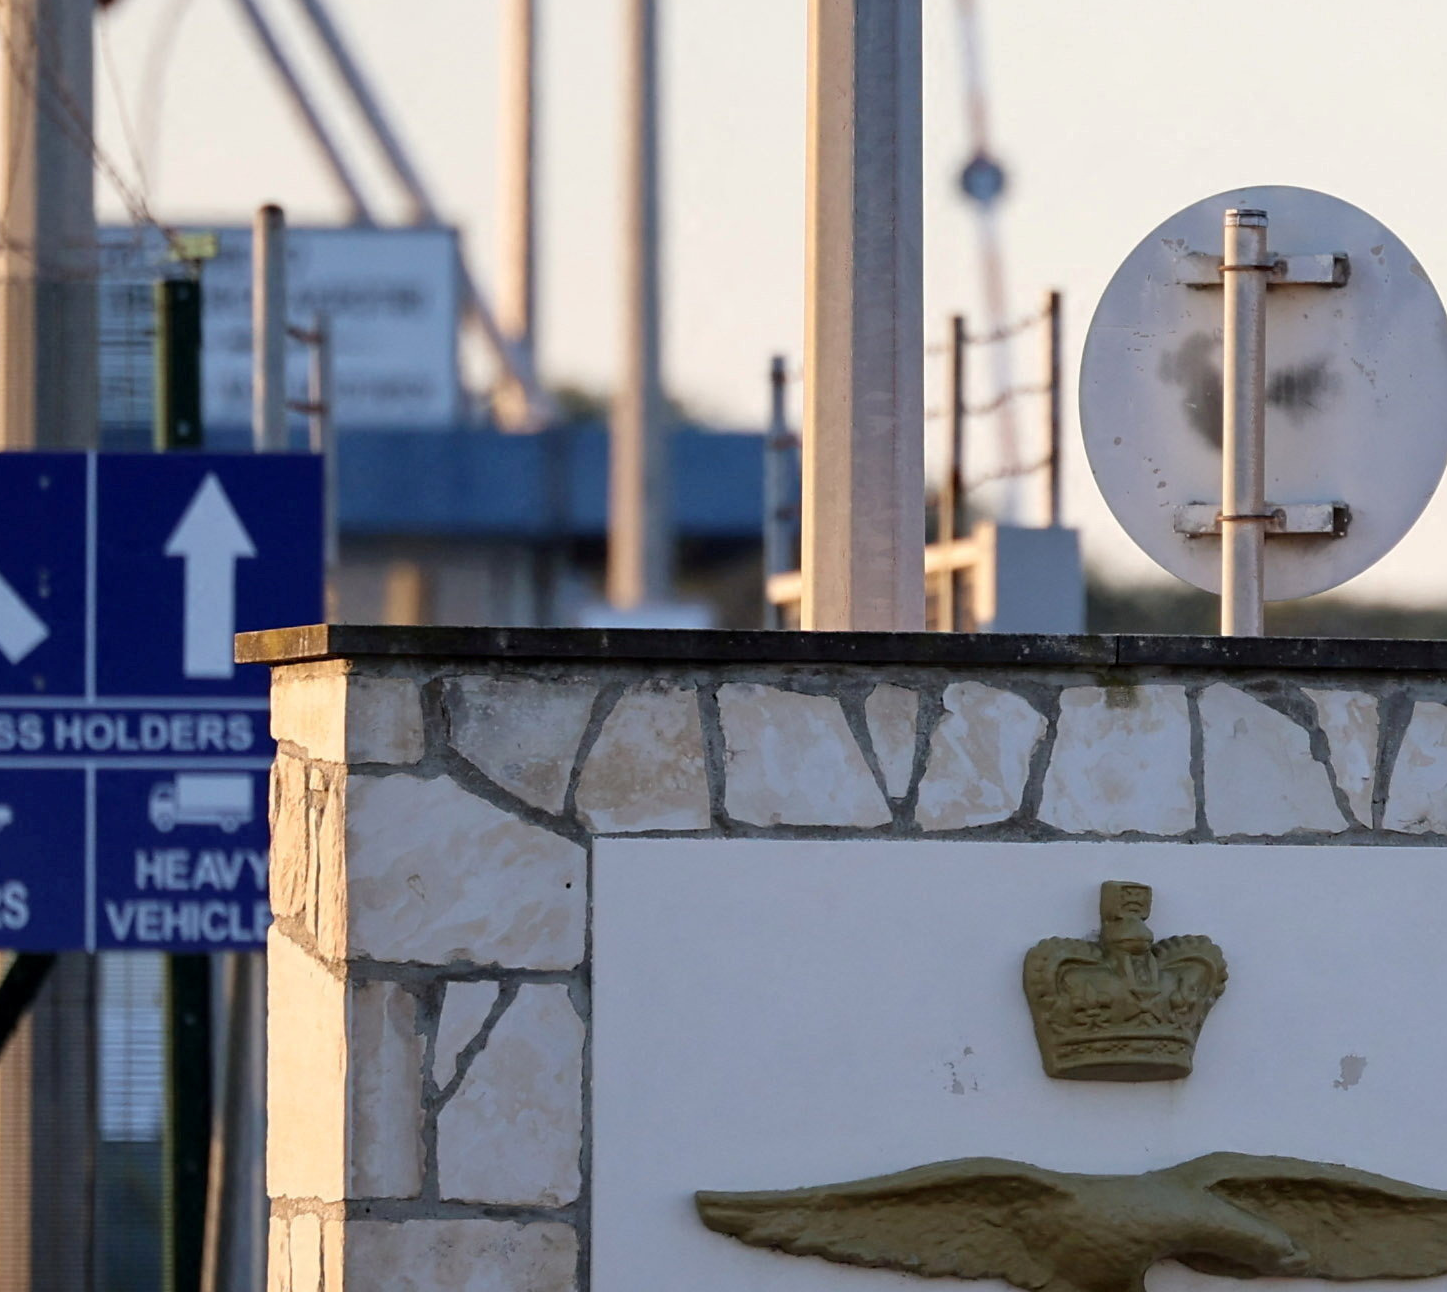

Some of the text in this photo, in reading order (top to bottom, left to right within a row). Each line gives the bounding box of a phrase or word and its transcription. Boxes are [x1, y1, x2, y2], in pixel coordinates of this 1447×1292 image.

[54, 713, 254, 751] HOLDERS
[135, 848, 270, 891] HEAVY
[105, 900, 270, 942] VEHICLE
